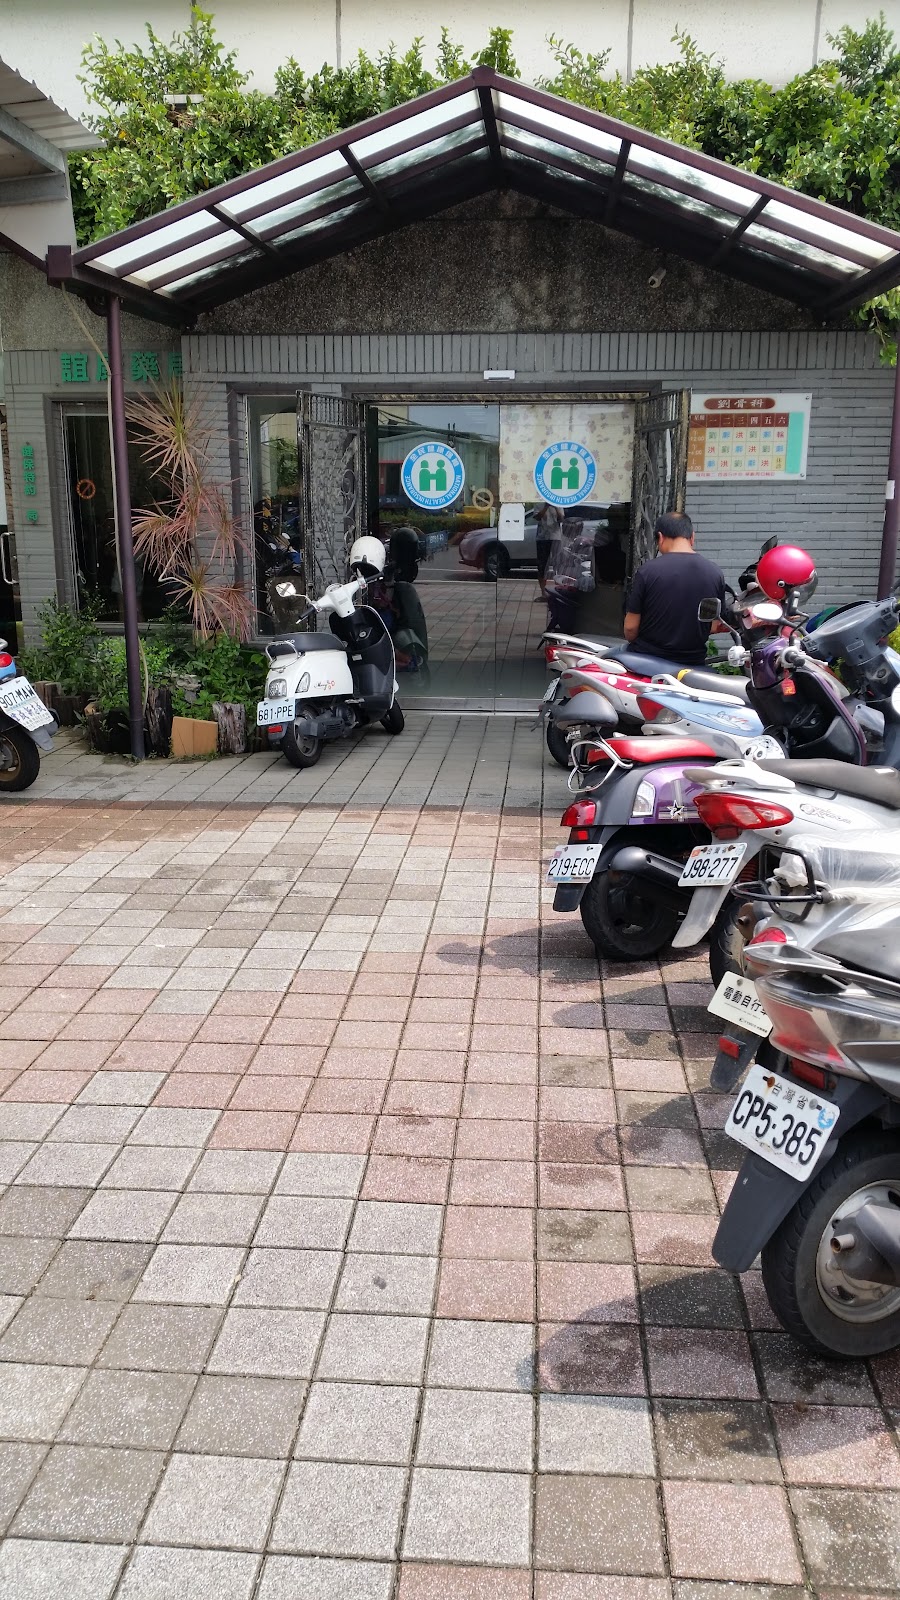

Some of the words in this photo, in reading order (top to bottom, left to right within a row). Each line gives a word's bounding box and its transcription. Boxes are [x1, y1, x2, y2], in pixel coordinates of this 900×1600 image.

[718, 399, 764, 408] 劉骨科
[750, 416, 759, 425] 四
[764, 415, 772, 425] 五
[777, 415, 787, 425] 六
[772, 1083, 809, 1111] 台灣省
